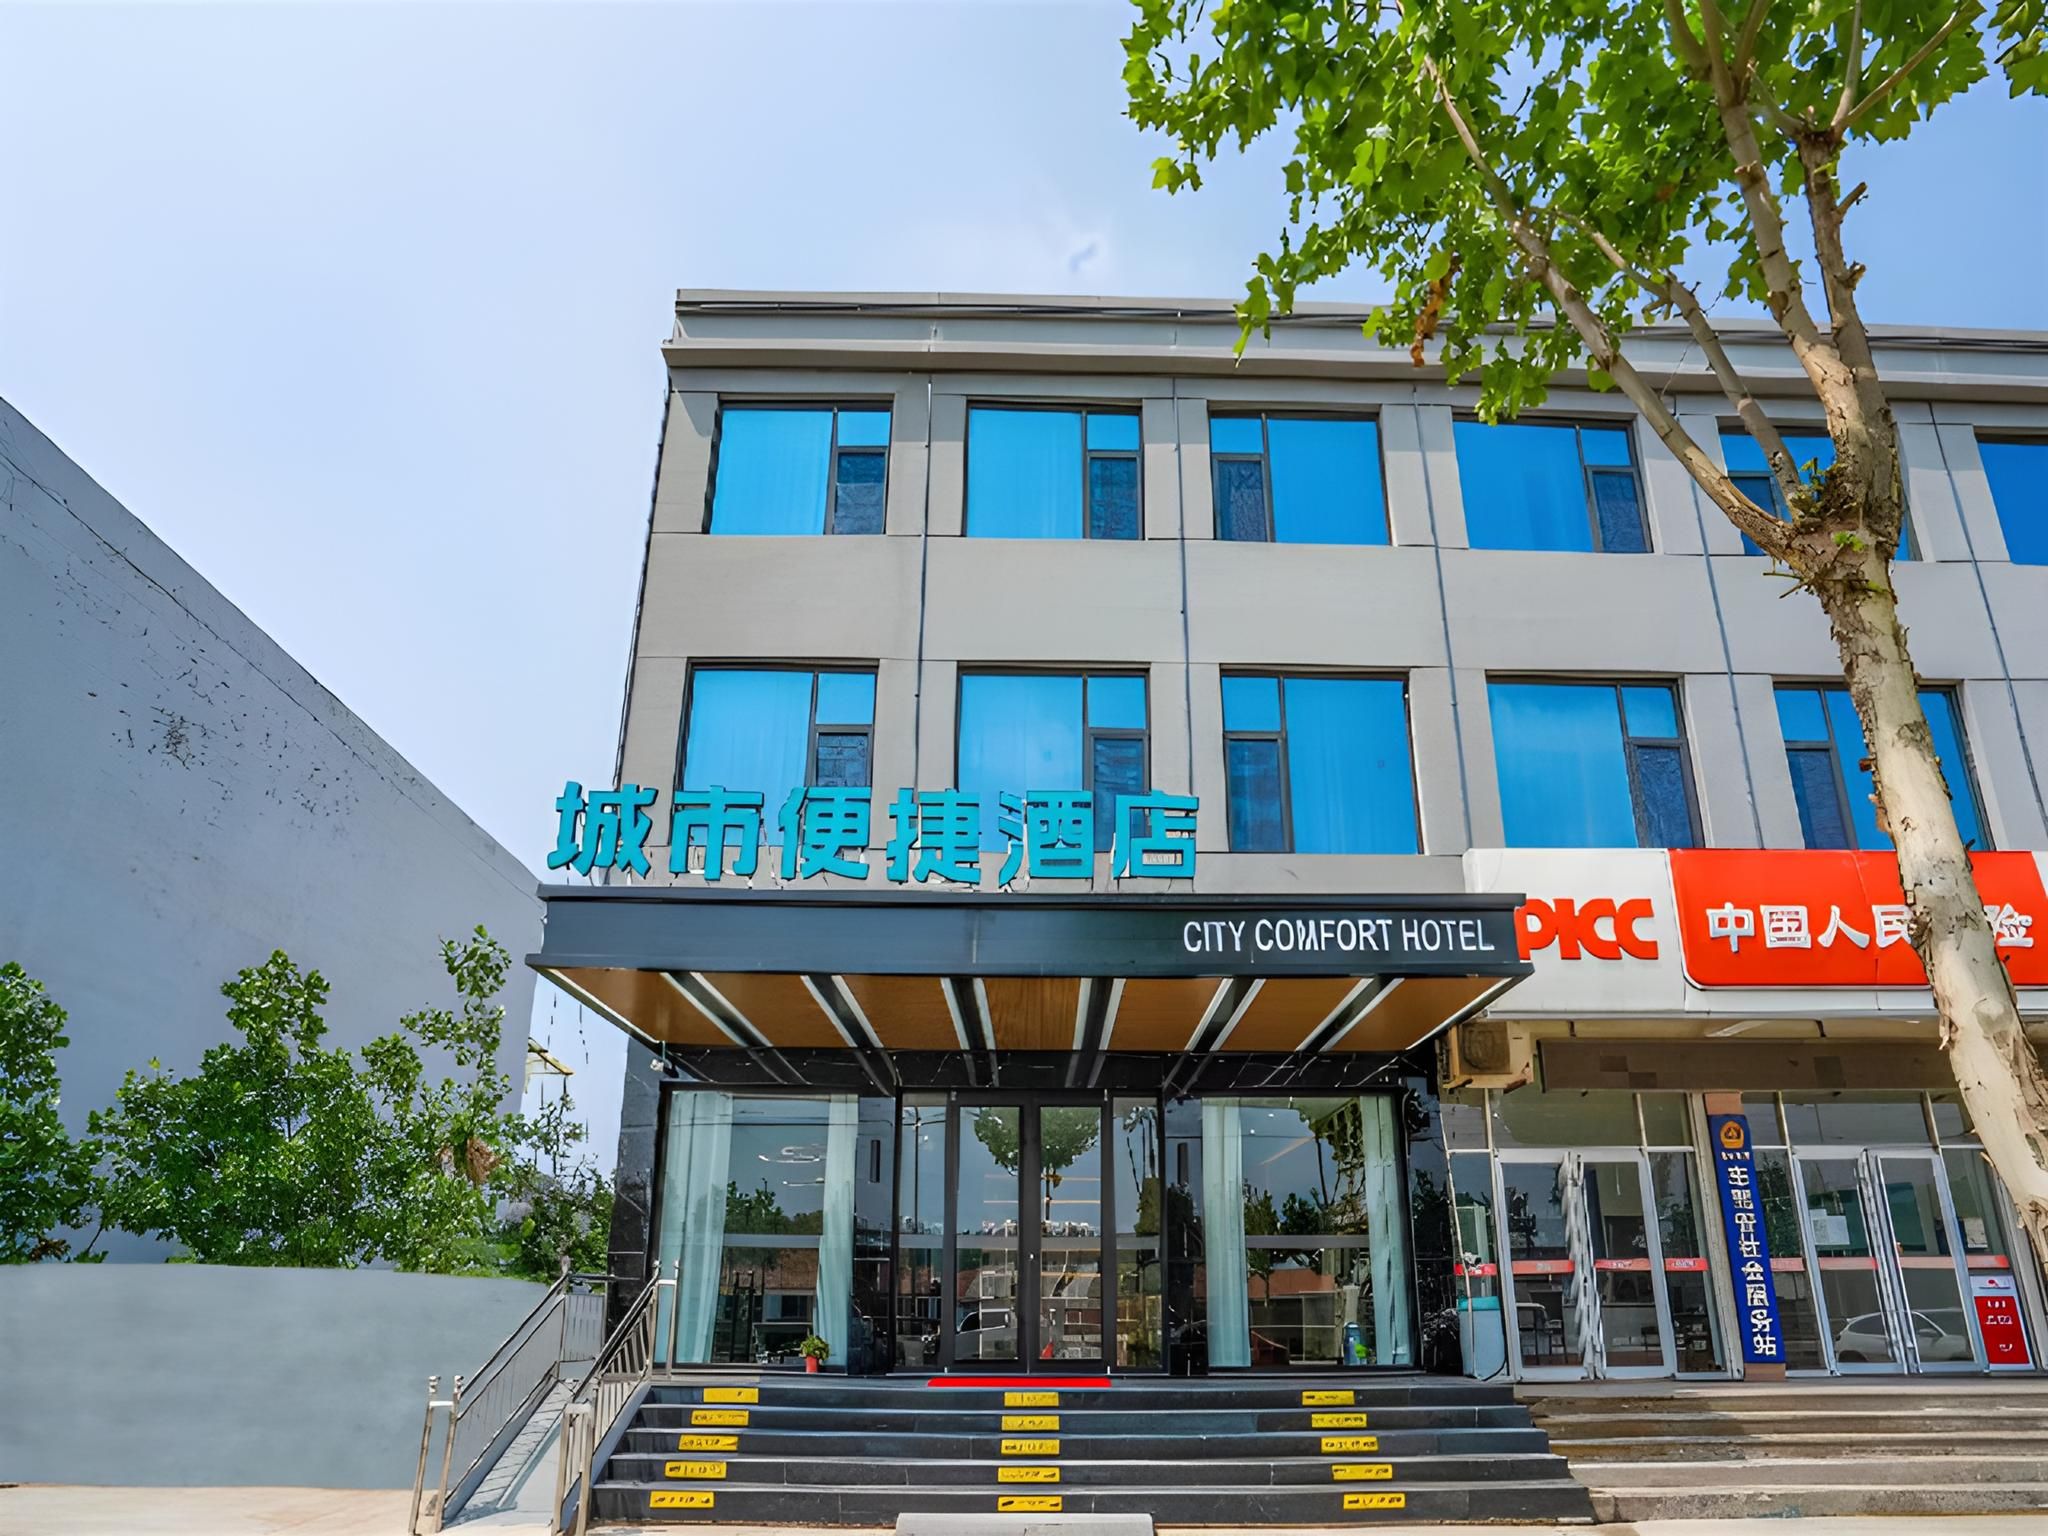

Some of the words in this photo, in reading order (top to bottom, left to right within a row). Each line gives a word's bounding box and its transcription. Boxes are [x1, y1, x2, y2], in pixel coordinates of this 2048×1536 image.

[547, 781, 1199, 886] 城市便捷酒店
[1183, 920, 1246, 953] CITY
[1255, 918, 1392, 952] COMFORT
[1402, 918, 1495, 952] HOTEL
[1514, 898, 1659, 960] PICC
[1706, 902, 2034, 952] 中国人民险
